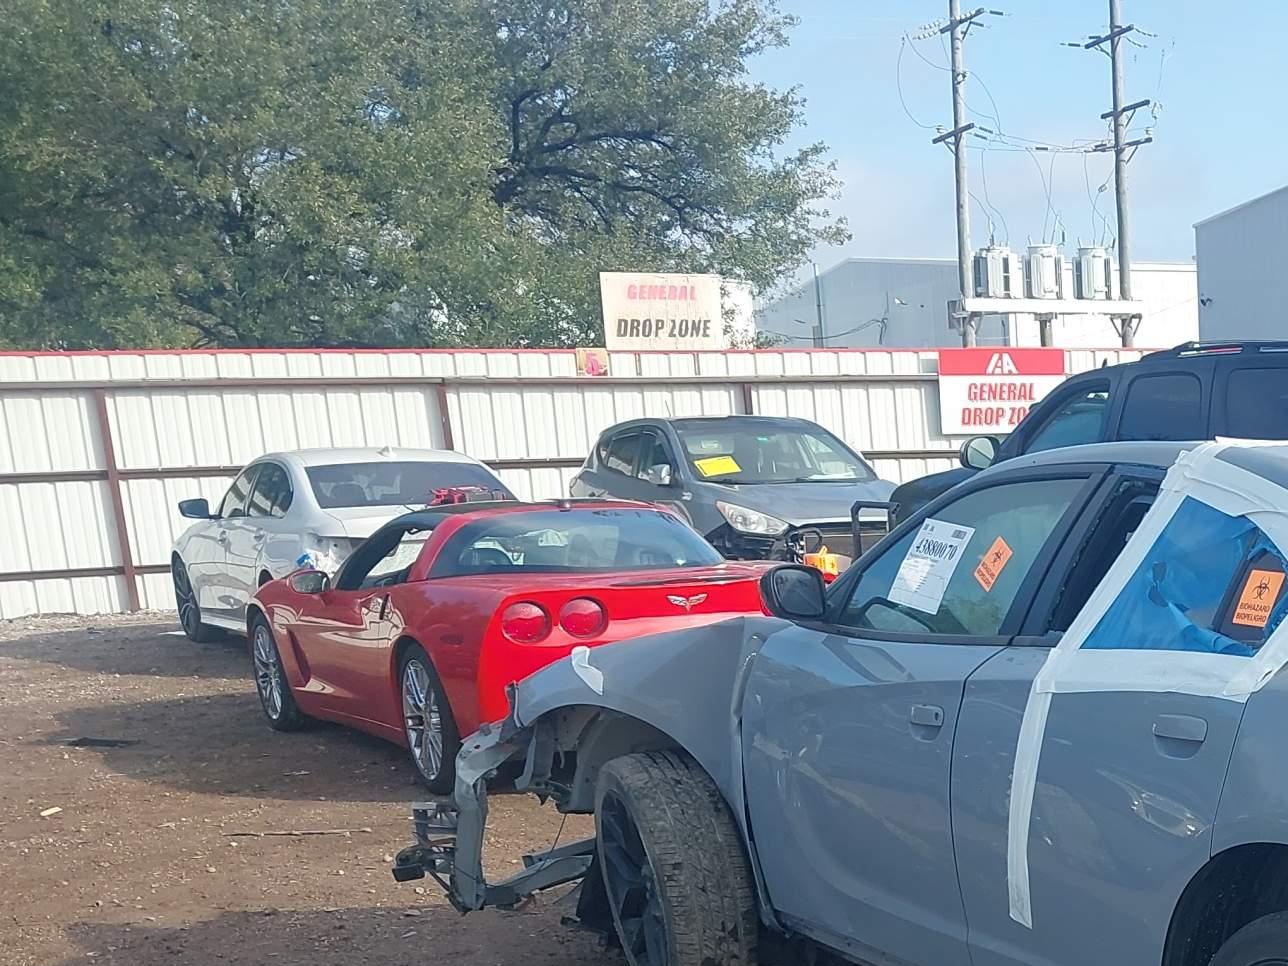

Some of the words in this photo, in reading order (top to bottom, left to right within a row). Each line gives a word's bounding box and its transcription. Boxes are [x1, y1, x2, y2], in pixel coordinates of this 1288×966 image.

[627, 283, 697, 300] GENERAL
[616, 318, 665, 338] DROP
[667, 318, 712, 338] ZONE
[967, 382, 1036, 401] GENERAL
[961, 407, 1005, 425] DROP
[915, 537, 959, 560] 43880070
